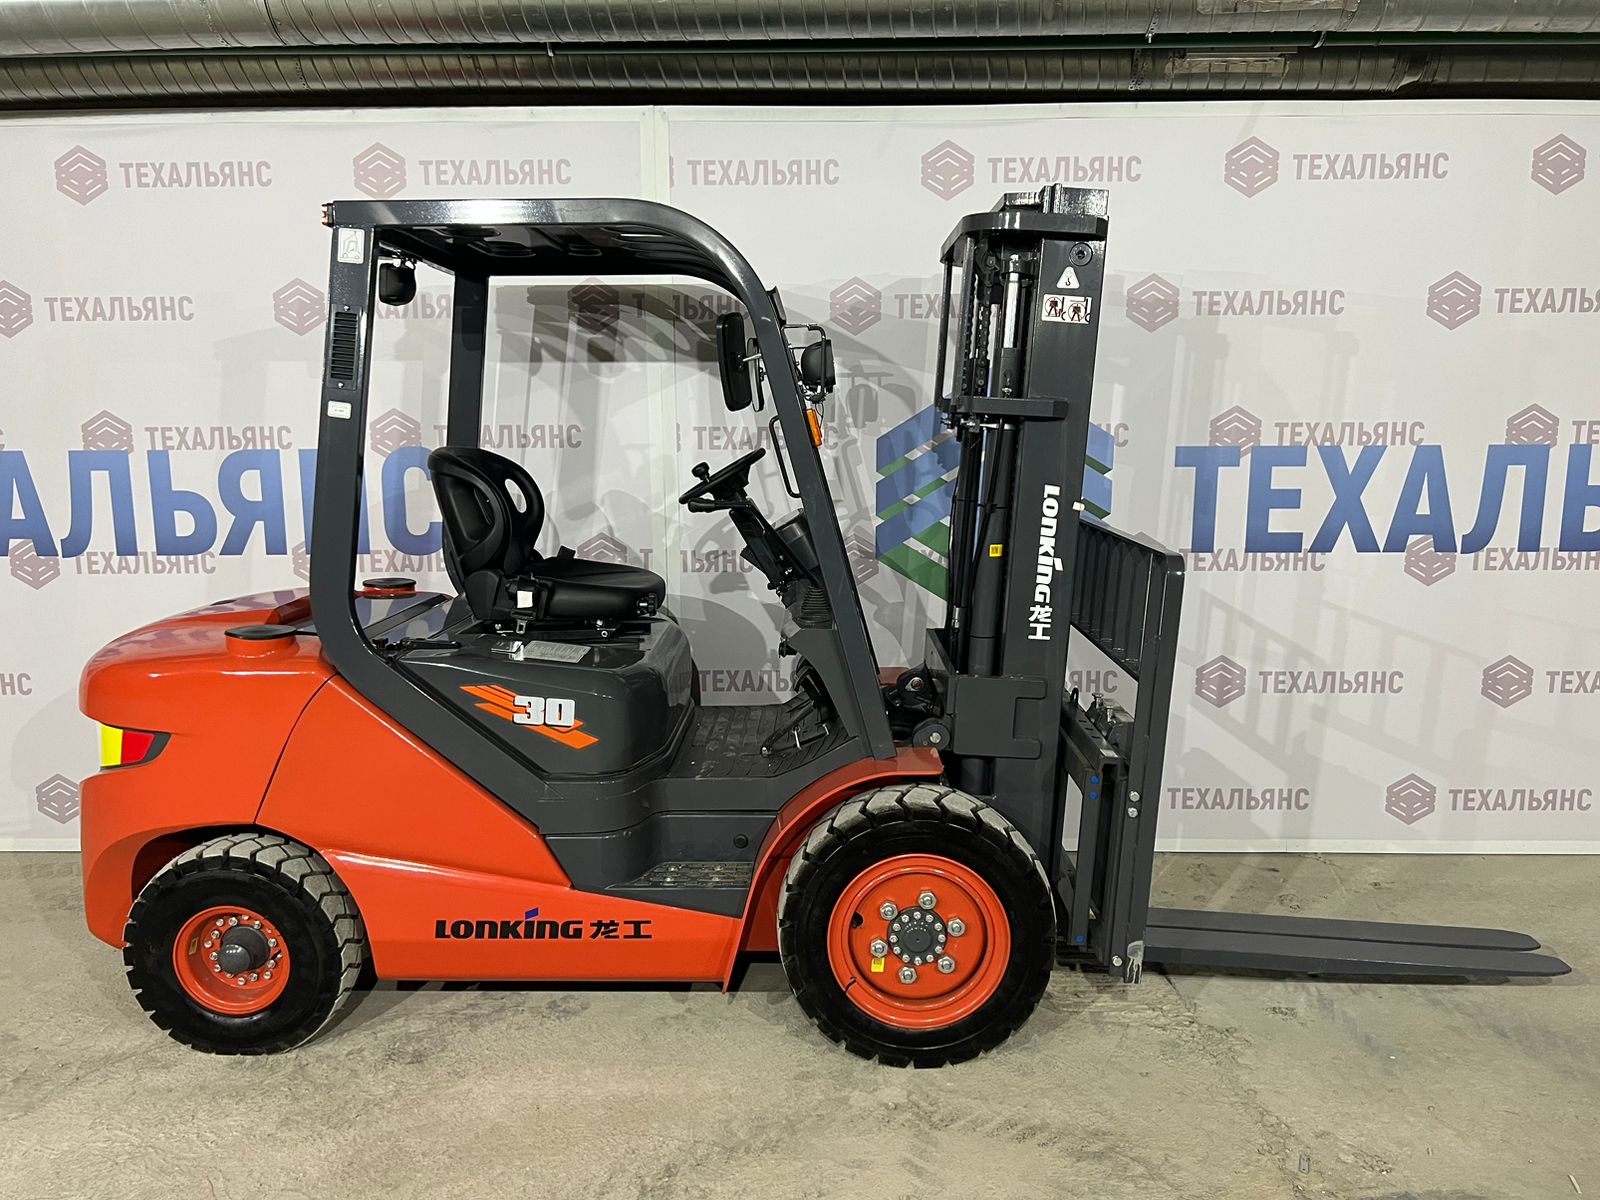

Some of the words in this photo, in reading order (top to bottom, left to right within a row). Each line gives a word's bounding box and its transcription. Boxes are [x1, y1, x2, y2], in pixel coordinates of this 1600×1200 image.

[119, 160, 272, 188] ТЕХАЛЬЯНС
[418, 158, 572, 186] ТЕХАЛЬЯНС
[687, 158, 840, 186] ТЕХАЛЬЯНС
[987, 155, 1143, 184] ТЕХАЛЬЯНС
[1293, 152, 1449, 181] ТЕХАЛЬЯНС
[44, 295, 194, 322] ТЕХАЛЬЯНС
[1192, 289, 1345, 316] ТЕХАЛЬЯНС
[144, 425, 293, 451] ТЕХАЛЬЯНС
[433, 424, 582, 449] ТАЛЬЯНС
[1274, 422, 1425, 447] ТЕХАЛЬЯНС
[1258, 670, 1404, 694] ТЕХАЛЬЯНС
[513, 695, 575, 728] 30
[1167, 787, 1310, 811] ТЕХАЛЬЯНС
[1448, 788, 1593, 812] ТЕХАЛЬЯНС
